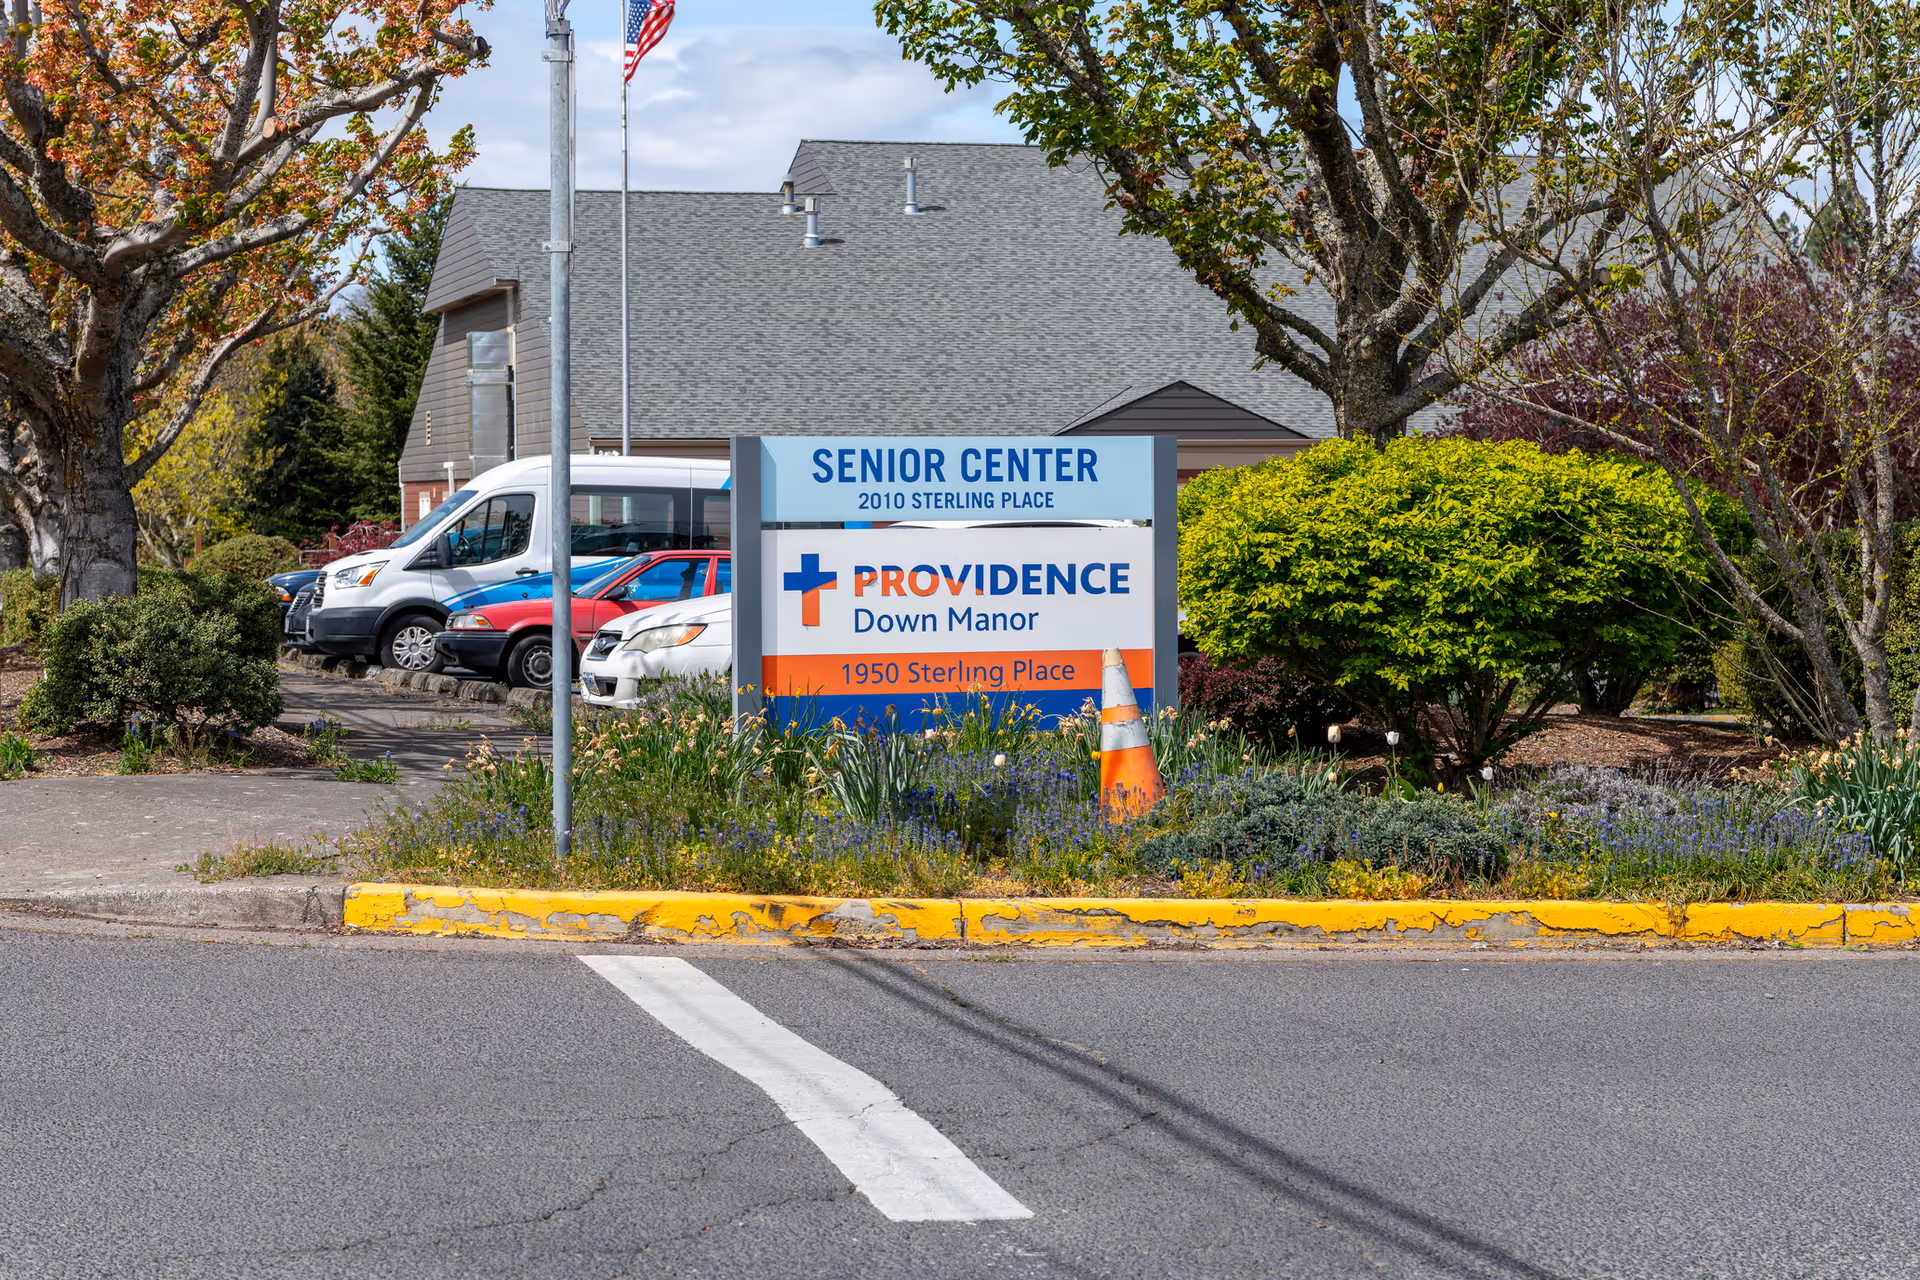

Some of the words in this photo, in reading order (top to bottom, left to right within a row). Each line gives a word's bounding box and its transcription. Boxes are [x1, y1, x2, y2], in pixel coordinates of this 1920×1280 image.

[812, 447, 946, 483] SENIOR
[960, 447, 1099, 483] CENTER
[858, 492, 905, 510] 2010
[911, 491, 995, 510] STERLING
[1001, 491, 1055, 509] PLACE
[854, 562, 1130, 597] PROVIDENCE
[854, 607, 938, 633] Down
[948, 606, 1040, 632] Manor
[841, 662, 900, 685] 1950
[908, 659, 1004, 688] Sterling
[1013, 658, 1076, 681] Place
